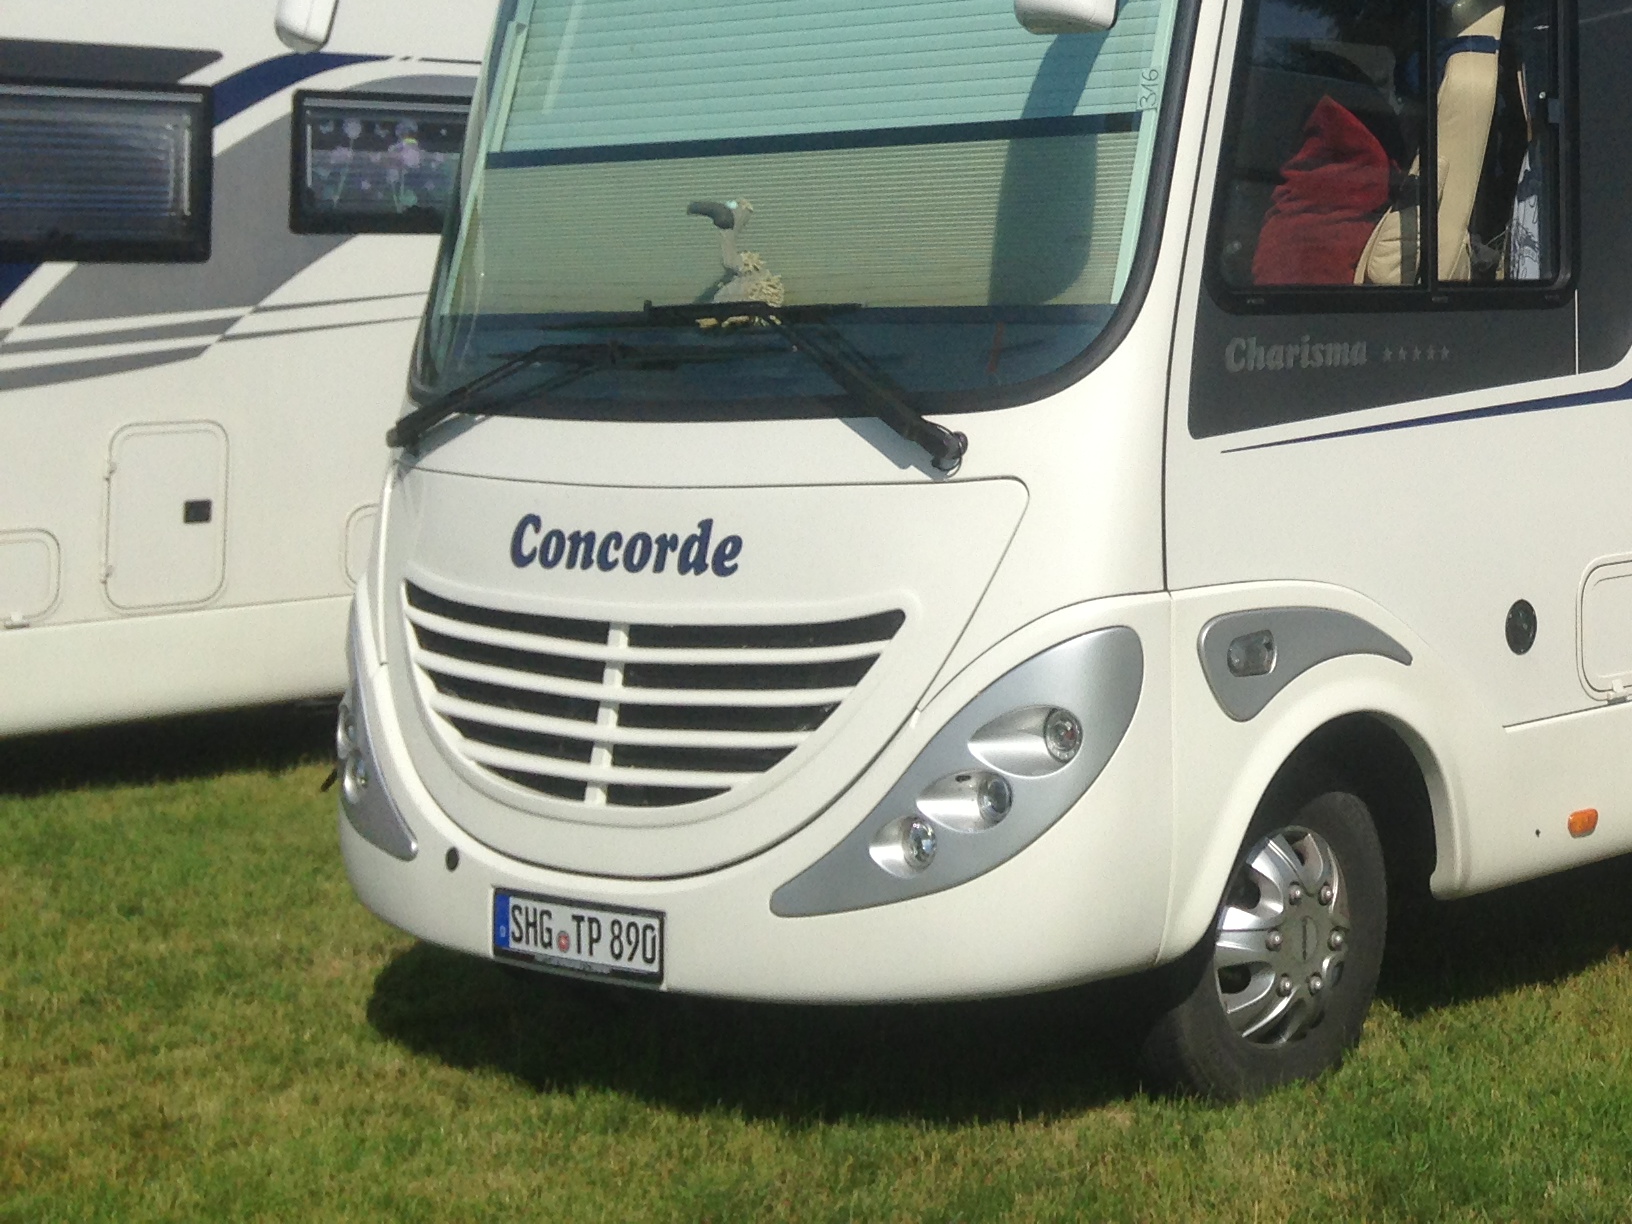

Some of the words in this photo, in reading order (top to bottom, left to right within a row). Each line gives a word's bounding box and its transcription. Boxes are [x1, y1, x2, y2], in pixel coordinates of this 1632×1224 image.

[1225, 334, 1368, 373] Charisma
[510, 513, 743, 577] Concorde
[511, 903, 554, 950] SHG
[571, 914, 602, 957] TP
[610, 918, 656, 964] 890
